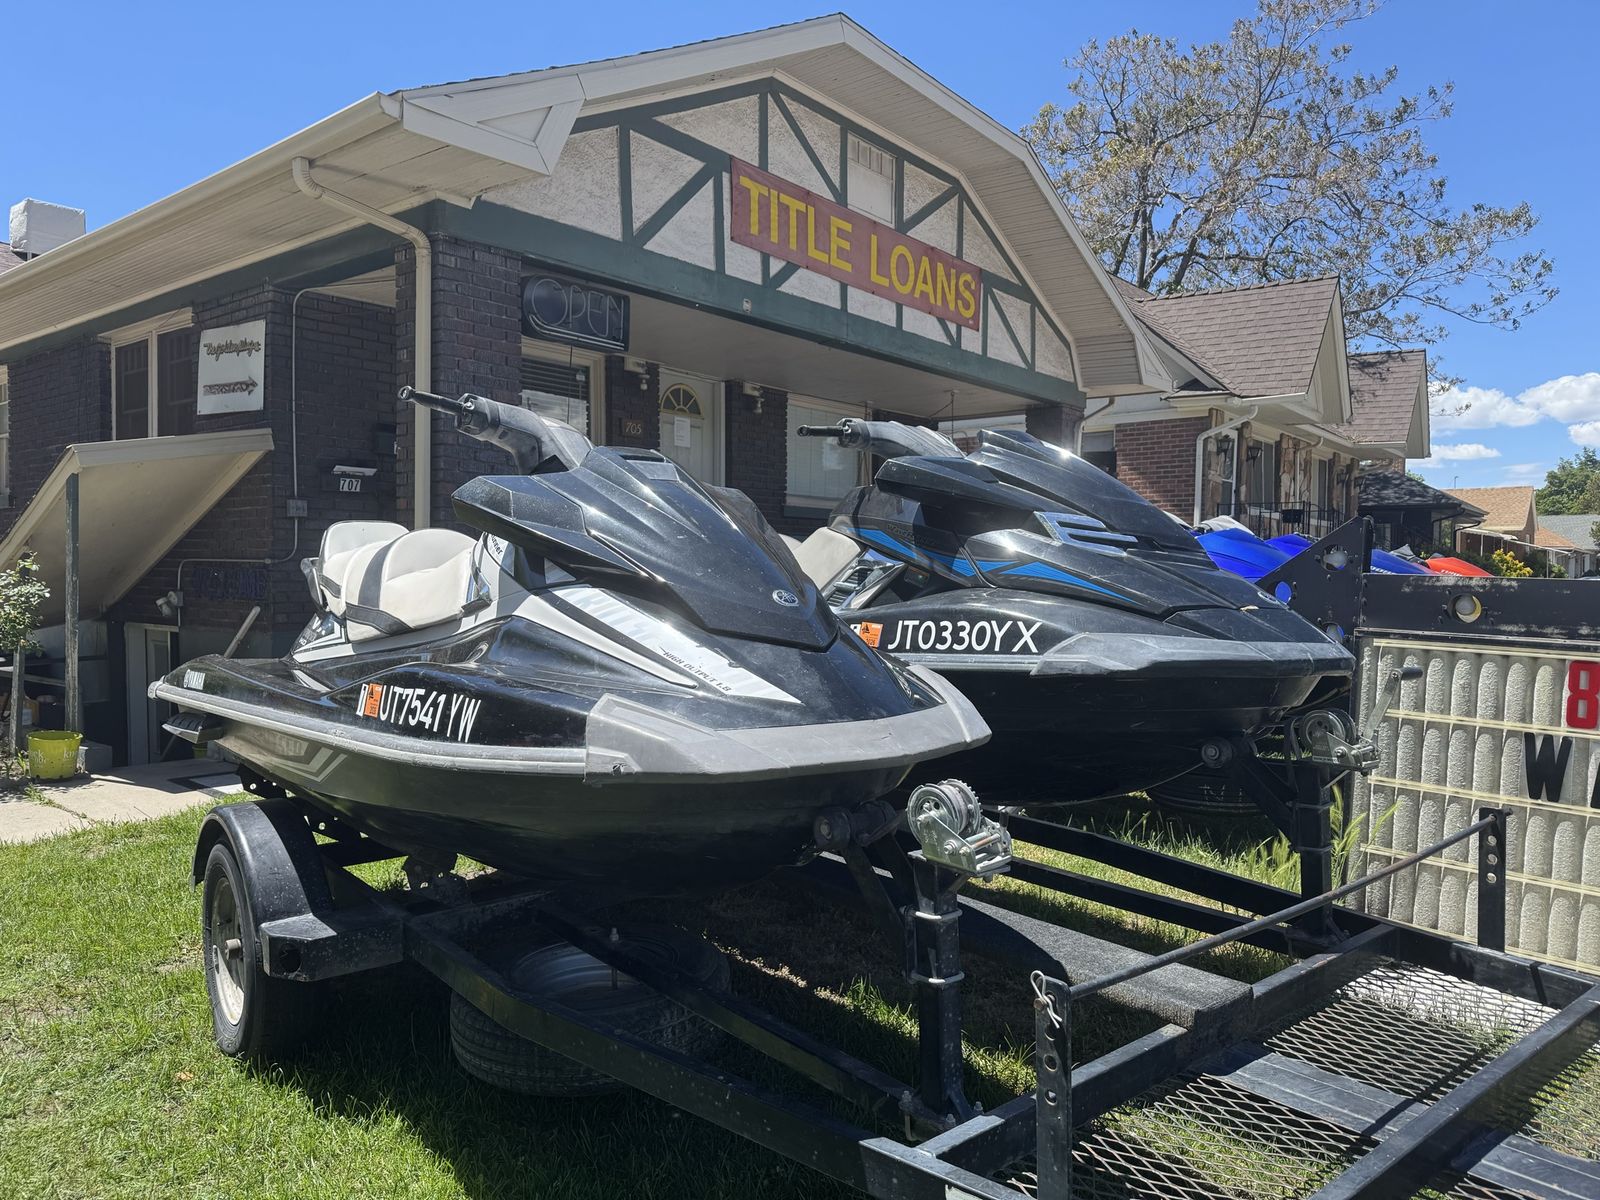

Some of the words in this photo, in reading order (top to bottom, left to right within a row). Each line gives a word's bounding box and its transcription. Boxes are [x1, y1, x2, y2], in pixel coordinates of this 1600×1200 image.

[739, 175, 852, 273] TITLE
[870, 234, 976, 319] LOANS
[531, 278, 625, 341] OPEN
[341, 479, 360, 491] 707
[662, 650, 685, 665] HIGH
[683, 663, 718, 683] OUTPUT
[1566, 659, 1600, 730] 8
[1523, 731, 1600, 808] W
